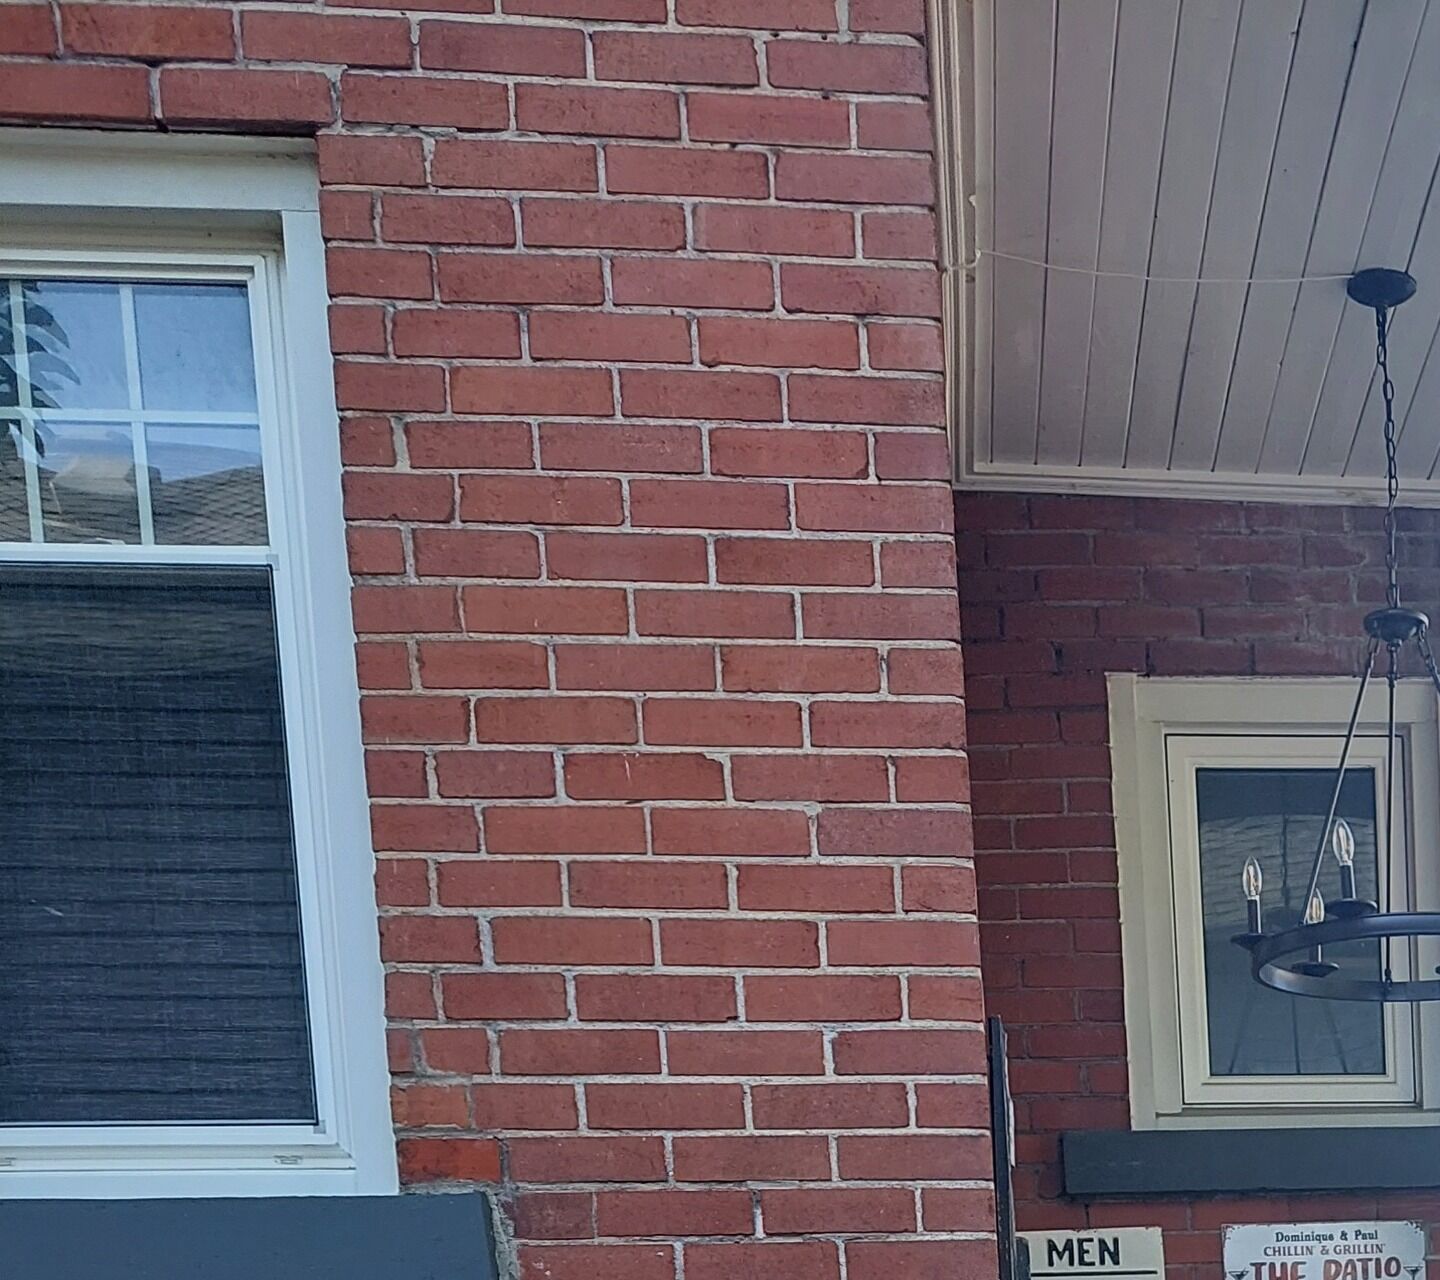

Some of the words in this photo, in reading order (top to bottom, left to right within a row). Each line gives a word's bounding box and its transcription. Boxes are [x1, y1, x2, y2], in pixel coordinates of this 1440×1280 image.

[1275, 1231, 1334, 1244] Dominique
[1340, 1230, 1348, 1240] &
[1354, 1230, 1378, 1240] Paul
[1047, 1237, 1120, 1267] MEN
[1320, 1245, 1330, 1255] &
